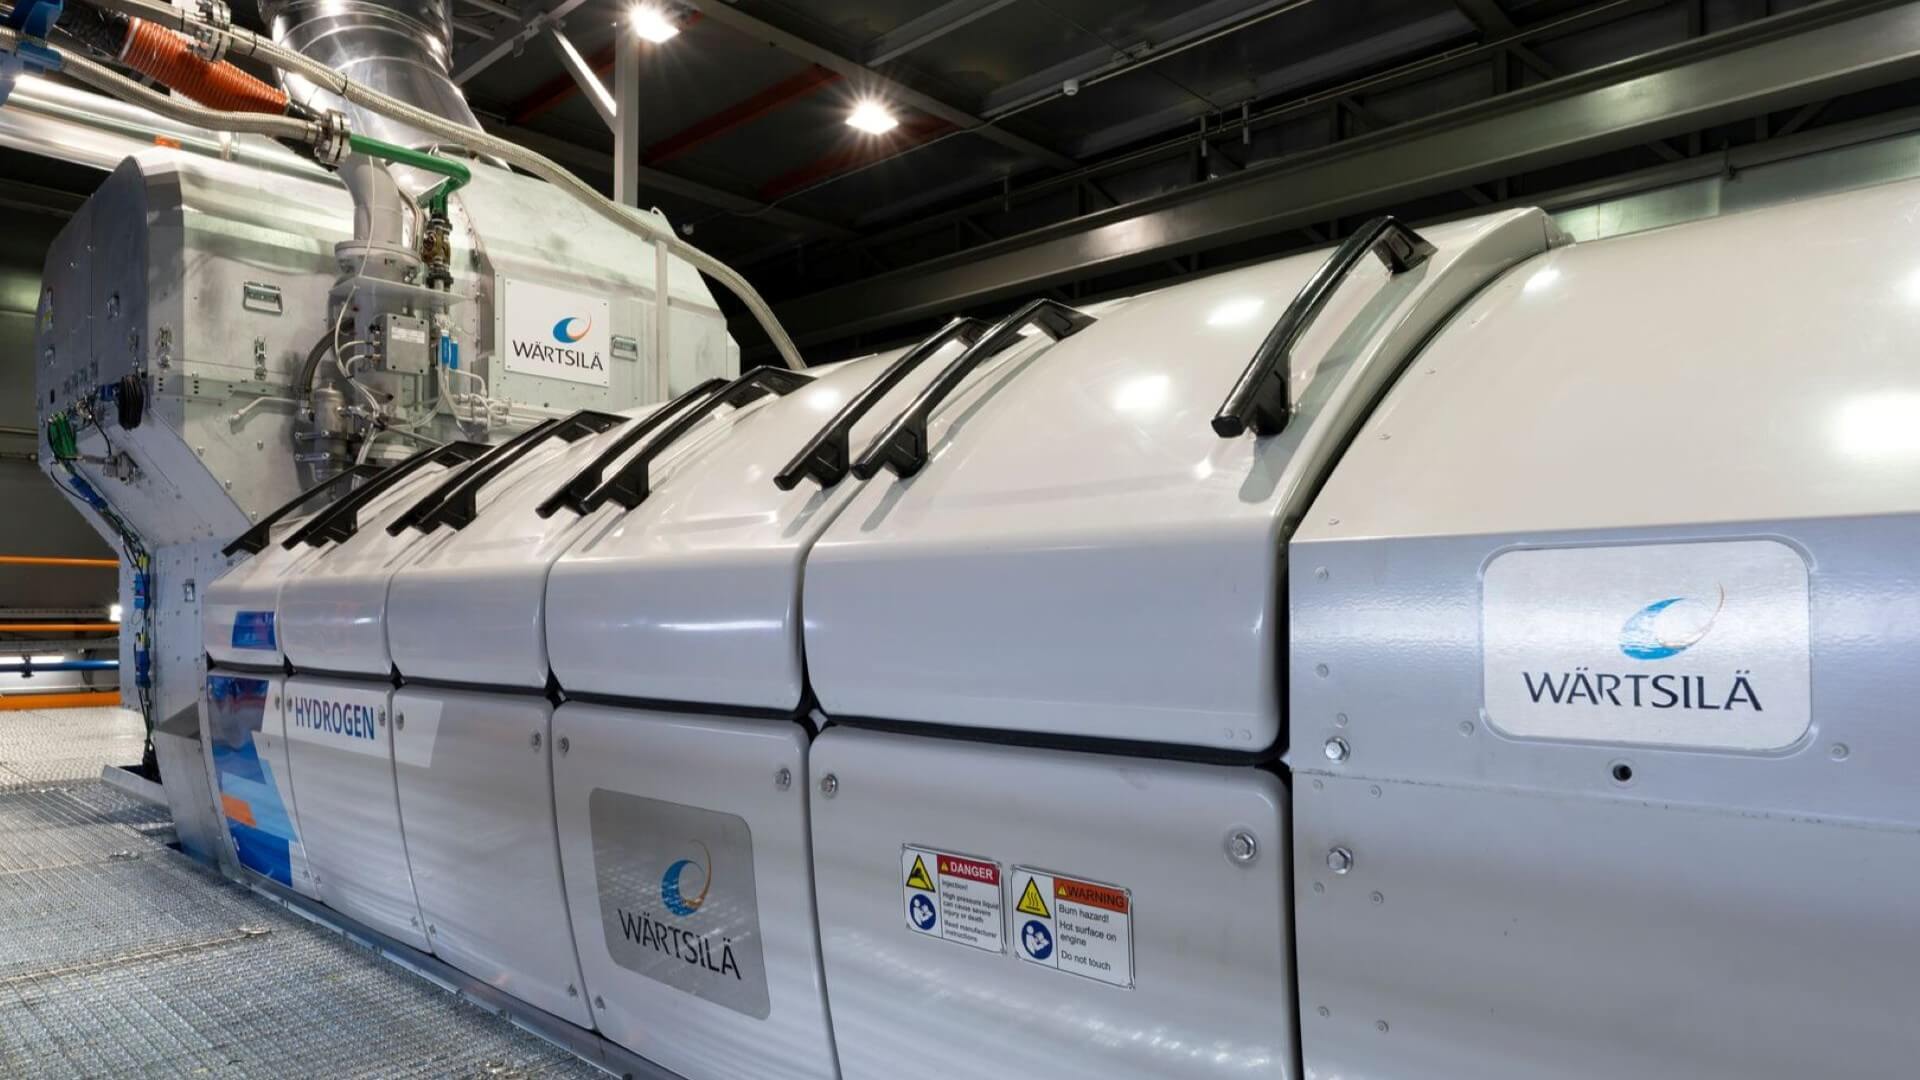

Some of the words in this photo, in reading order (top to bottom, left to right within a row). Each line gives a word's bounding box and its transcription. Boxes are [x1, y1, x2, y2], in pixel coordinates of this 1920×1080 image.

[512, 339, 604, 372] WÄRTSILÄ
[1522, 666, 1763, 712] WÄRTSILÄ
[295, 696, 375, 740] HYDROGEN
[950, 861, 994, 880] DANGER
[943, 891, 956, 901] High
[957, 895, 981, 906] pressure
[982, 900, 999, 910] liquid
[1067, 885, 1124, 908] WARNING
[943, 900, 954, 908] can
[955, 903, 971, 912] cause
[973, 907, 991, 917] severe
[968, 914, 984, 923] death
[1059, 903, 1078, 916] Burn
[1080, 908, 1110, 923] hazard!
[960, 924, 997, 939] manufacturer
[1059, 920, 1074, 932] Hot
[1075, 924, 1104, 939] surface
[1106, 932, 1117, 942] on
[1060, 933, 1087, 947] engine
[617, 908, 742, 981] WÄRTSILÄ
[1061, 949, 1072, 961] Do
[1074, 953, 1087, 965] not
[1088, 957, 1111, 971] touch
